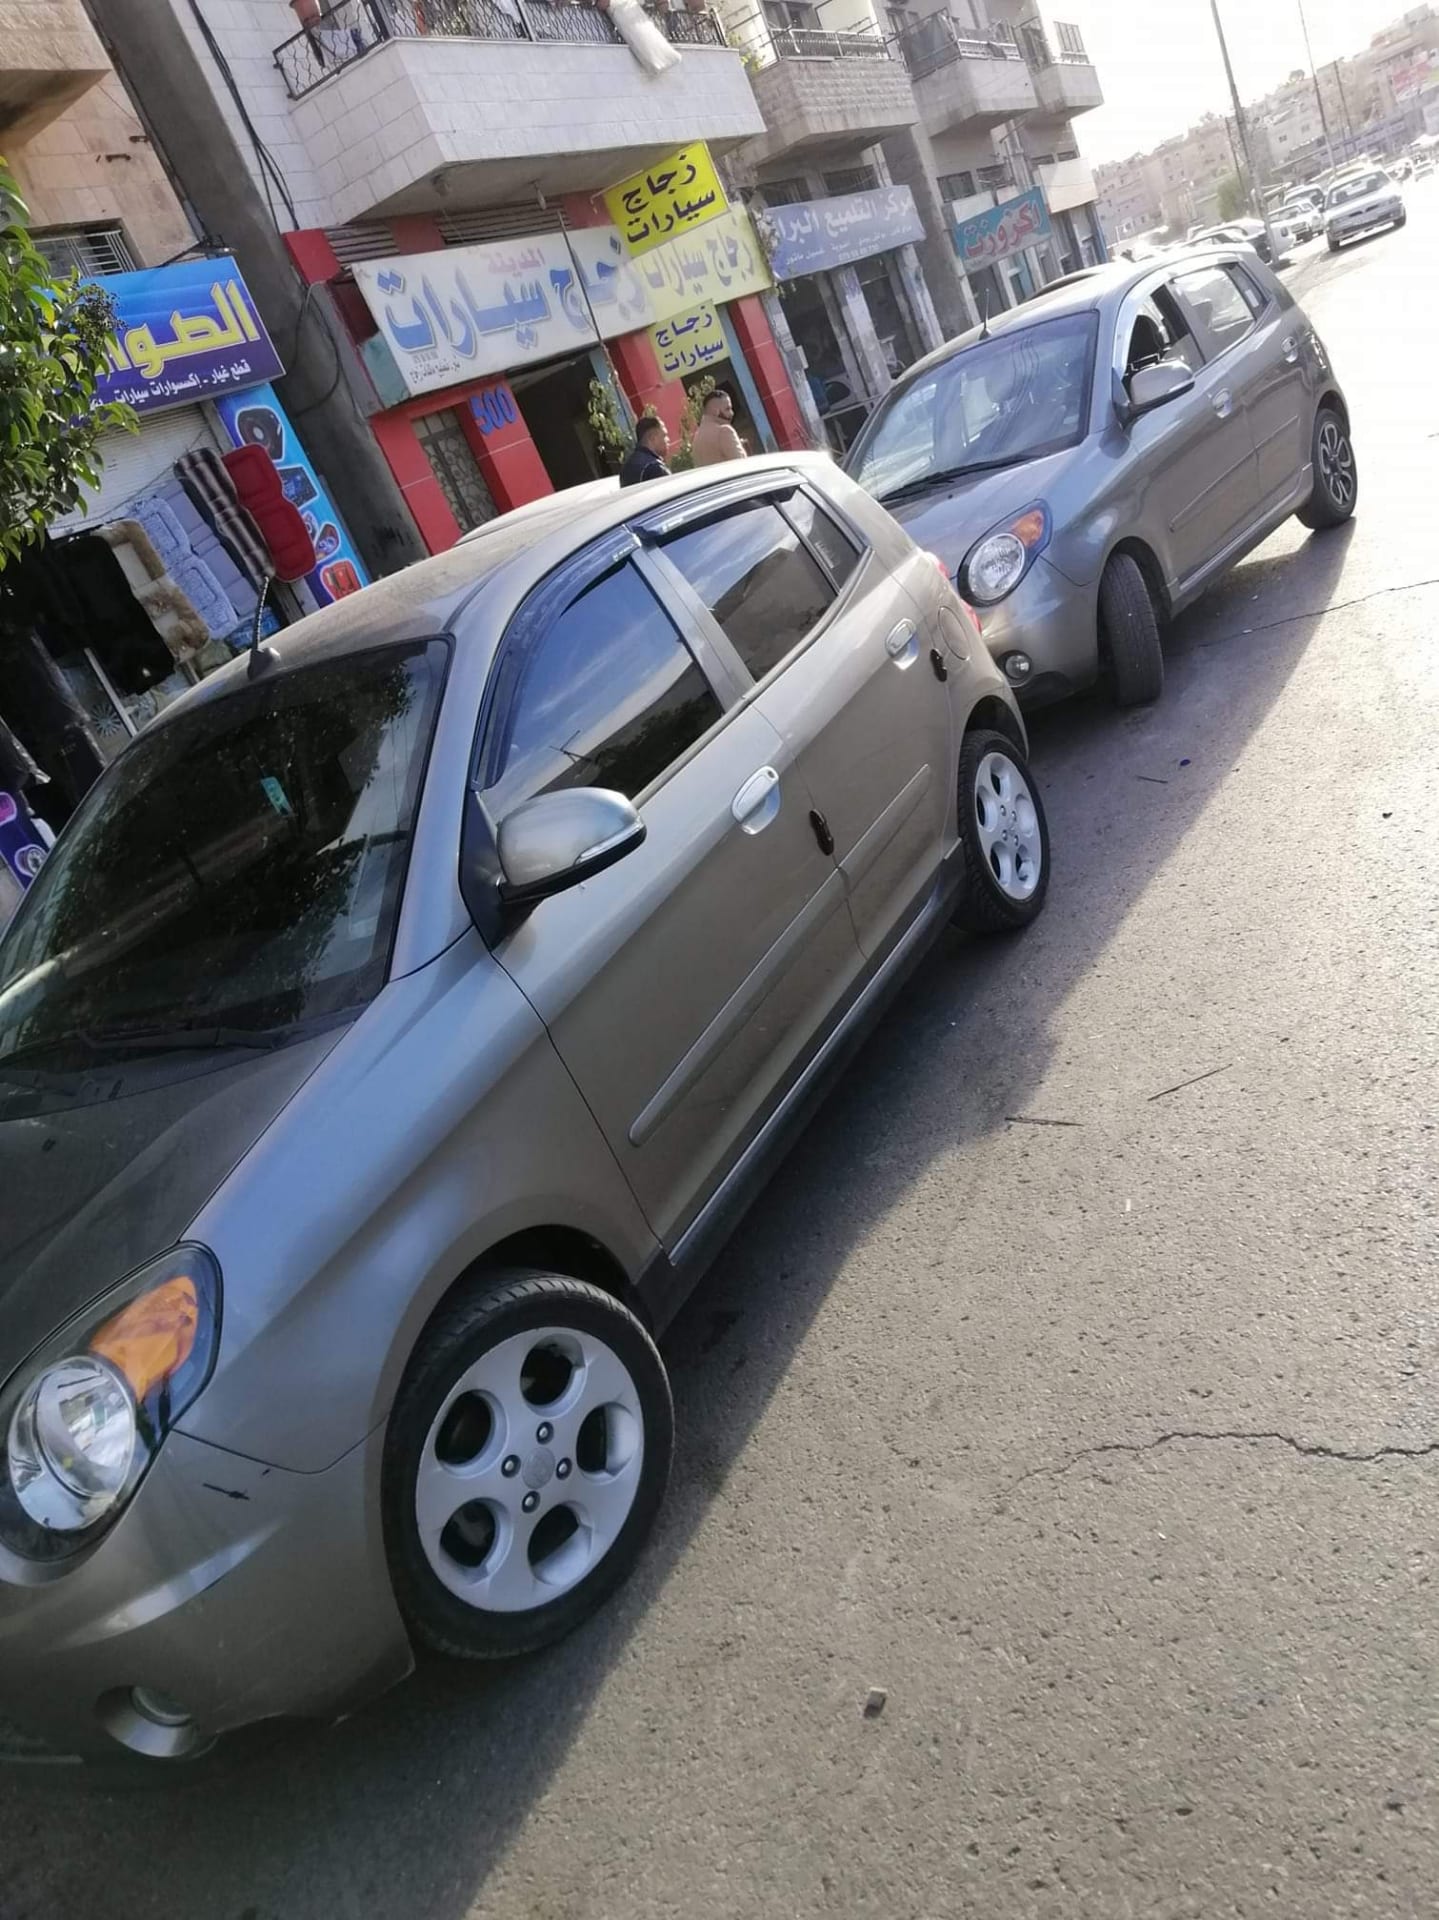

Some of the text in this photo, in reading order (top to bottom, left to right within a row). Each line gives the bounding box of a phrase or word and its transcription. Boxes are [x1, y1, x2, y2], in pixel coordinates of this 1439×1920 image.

[621, 154, 697, 214] زجاج
[626, 189, 716, 243] سيارات
[776, 208, 820, 244] البرا
[824, 196, 878, 238] التلميع
[879, 191, 916, 222] مركز
[706, 219, 756, 287] زجاج
[376, 262, 552, 361] سيارات
[655, 305, 713, 348] زجاج
[211, 364, 230, 384] غيار
[230, 358, 252, 381] قطع
[664, 339, 724, 372] سيارات
[113, 388, 149, 405] سيارات
